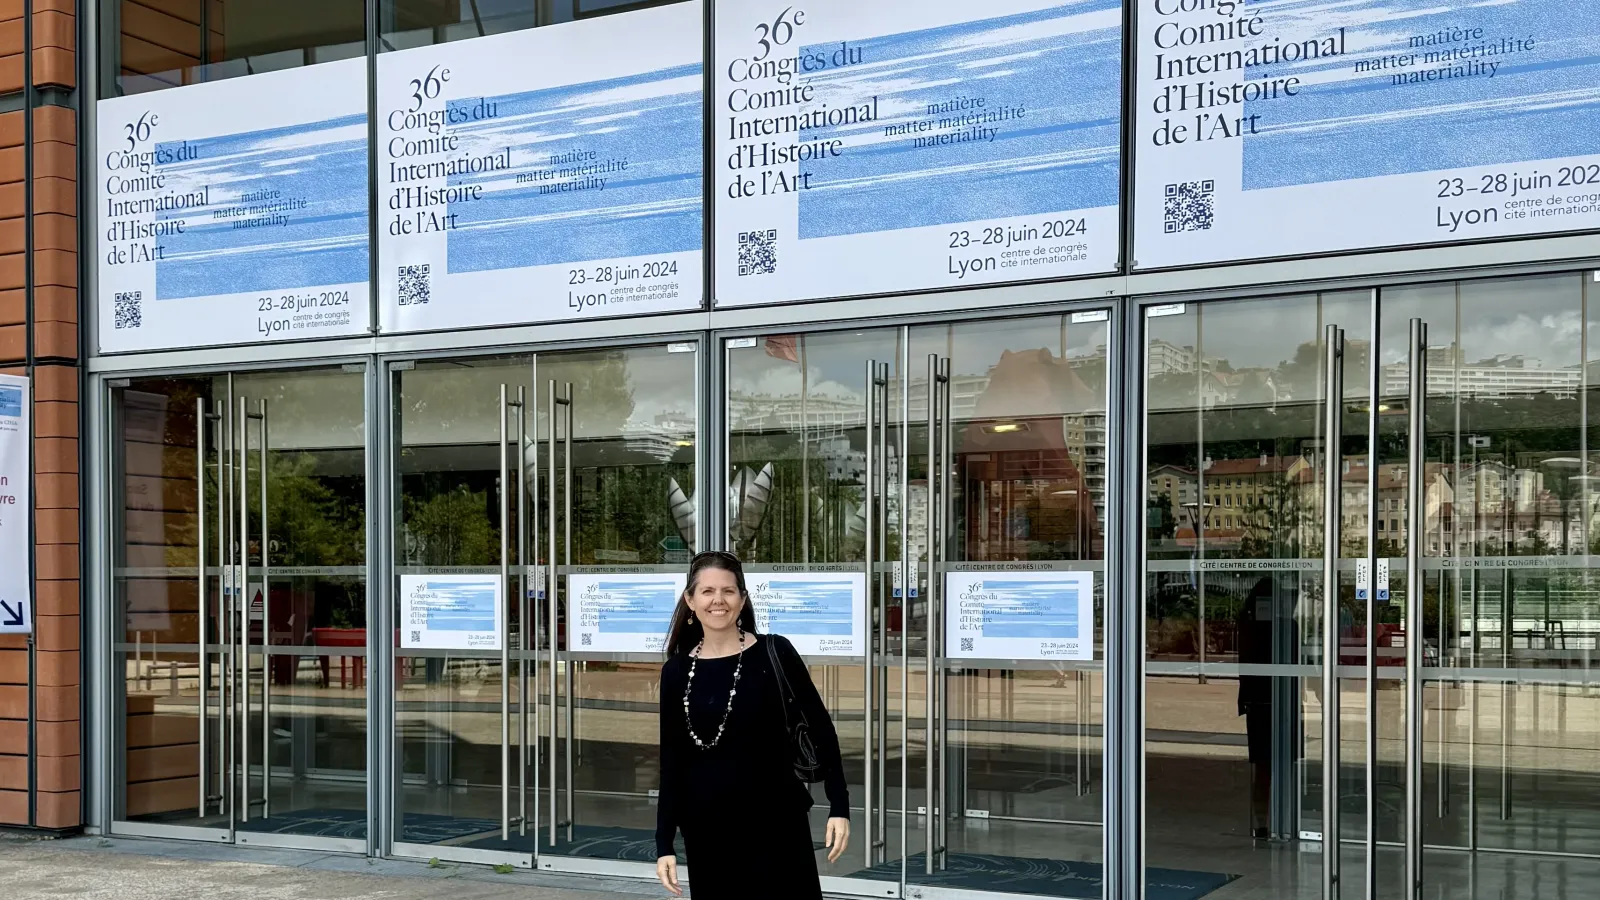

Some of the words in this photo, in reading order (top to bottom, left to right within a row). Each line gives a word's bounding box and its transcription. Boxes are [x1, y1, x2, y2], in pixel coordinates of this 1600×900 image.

[1154, 9, 1264, 49] Comité
[1409, 25, 1484, 48] matière
[728, 48, 826, 83] Congrès
[832, 41, 863, 68] du
[1155, 27, 1346, 80] International
[1355, 52, 1418, 74] matter
[1423, 35, 1535, 65] matérialité
[1391, 59, 1501, 87] materiality
[728, 79, 814, 112] Comité
[927, 96, 985, 115] matière
[1153, 74, 1300, 115] d’Histoire
[388, 103, 468, 133] Congrès
[473, 97, 498, 120] du
[729, 96, 879, 140] International
[884, 118, 935, 137] matter
[938, 104, 1026, 131] matérialité
[913, 127, 999, 150] materiality
[1153, 117, 1188, 147] de
[1195, 111, 1261, 142] l’Art
[106, 146, 173, 173] Congrès
[177, 141, 198, 162] du
[388, 130, 459, 159] Comité
[550, 149, 597, 165] matière
[728, 137, 843, 170] d’Histoire
[389, 147, 512, 183] International
[516, 169, 556, 184] matter
[559, 159, 628, 179] matérialité
[106, 169, 165, 195] Comité
[539, 176, 608, 196] materiality
[728, 173, 755, 199] de
[761, 168, 813, 196] l’Art
[1437, 173, 1508, 198] 23–28
[1511, 170, 1551, 197] juin
[1558, 164, 1600, 186] 202
[107, 185, 209, 217] International
[213, 206, 247, 219] matter
[249, 196, 307, 215] matérialité
[241, 189, 280, 202] matière
[389, 182, 483, 210] d’Histoire
[1504, 198, 1543, 210] centre
[1546, 195, 1562, 206] de
[232, 214, 290, 230] materiality
[389, 215, 412, 237] de
[417, 211, 458, 234] l’Art
[1437, 206, 1498, 232] Lyon
[1504, 209, 1526, 220] cité
[107, 217, 185, 241] d’Histoire
[949, 227, 1004, 248] 23–28
[1006, 224, 1038, 248] juin
[1042, 218, 1087, 239] 2024
[107, 247, 127, 265] de
[130, 243, 165, 263] l’Art
[1000, 249, 1031, 259] centre
[1033, 246, 1046, 255] de
[1048, 242, 1088, 254] congrès
[1000, 258, 1018, 268] cité
[1020, 252, 1087, 266] internationale
[569, 267, 613, 285] 23–28
[614, 265, 639, 285] juin
[643, 260, 678, 278] 2024
[949, 255, 996, 279] Lyon
[258, 296, 295, 311] 23–28
[296, 294, 317, 312] juin
[320, 291, 349, 306] 2024
[569, 291, 607, 312] Lyon
[610, 286, 634, 295] centre
[636, 284, 646, 293] de
[610, 295, 624, 303] cité
[626, 290, 679, 302] internationale
[258, 317, 290, 336] Lyon
